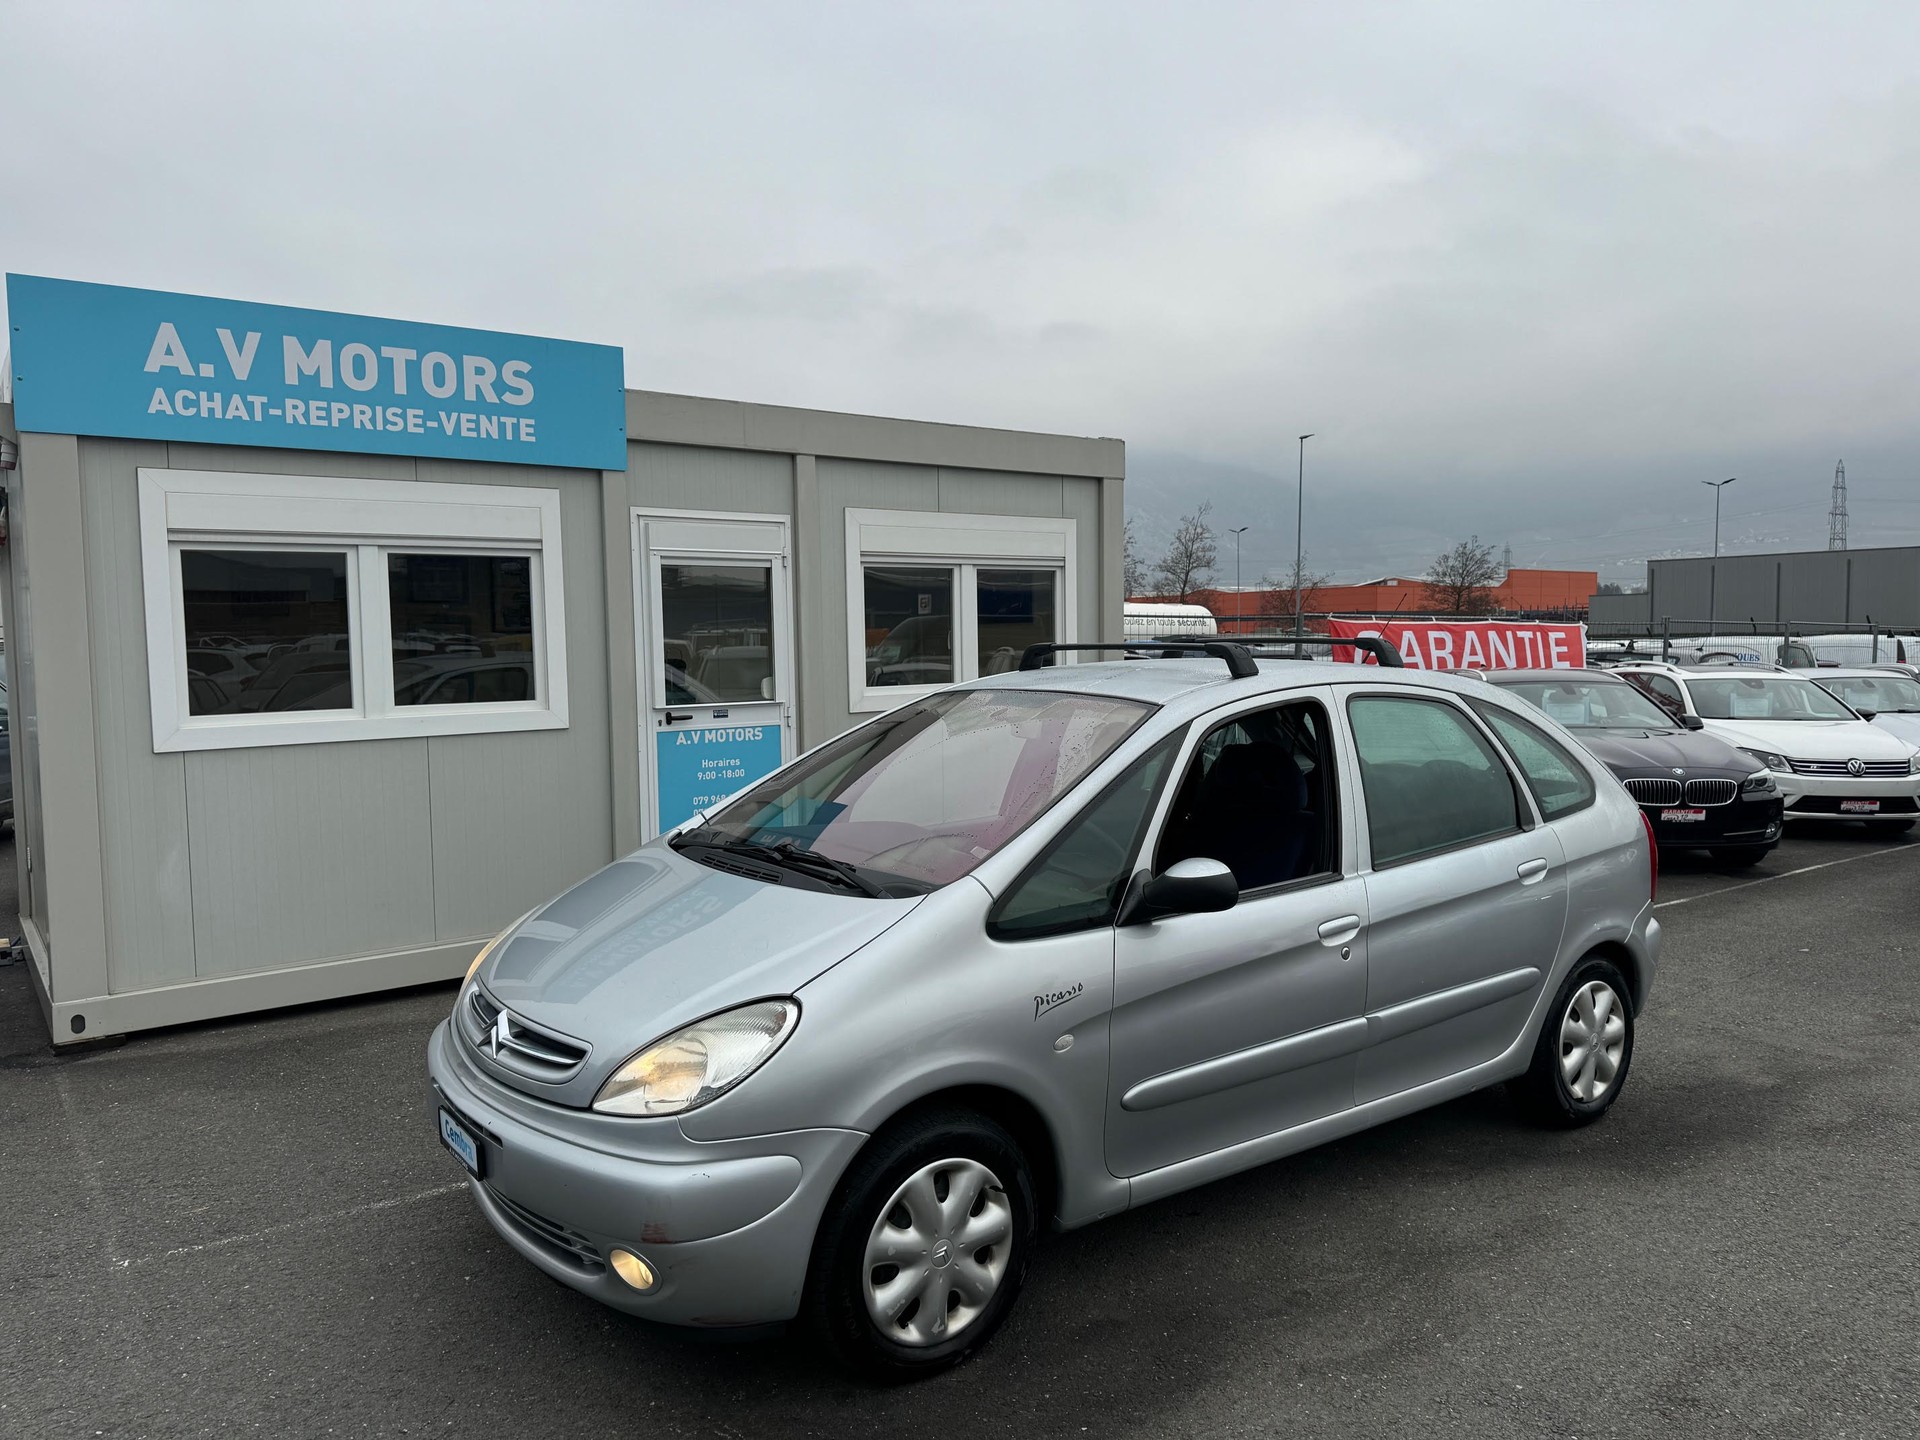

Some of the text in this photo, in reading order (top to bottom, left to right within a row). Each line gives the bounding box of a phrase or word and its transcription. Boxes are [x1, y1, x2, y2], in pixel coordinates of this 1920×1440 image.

[143, 322, 534, 406] A.V MOTORS
[148, 388, 536, 442] ACHAT-REPRISE-VENTE
[676, 727, 763, 745] A.V MOTORS
[702, 758, 740, 768] Horaires
[697, 771, 716, 780] 9:00
[693, 796, 708, 805] 079
[1034, 982, 1084, 1022] Picasso
